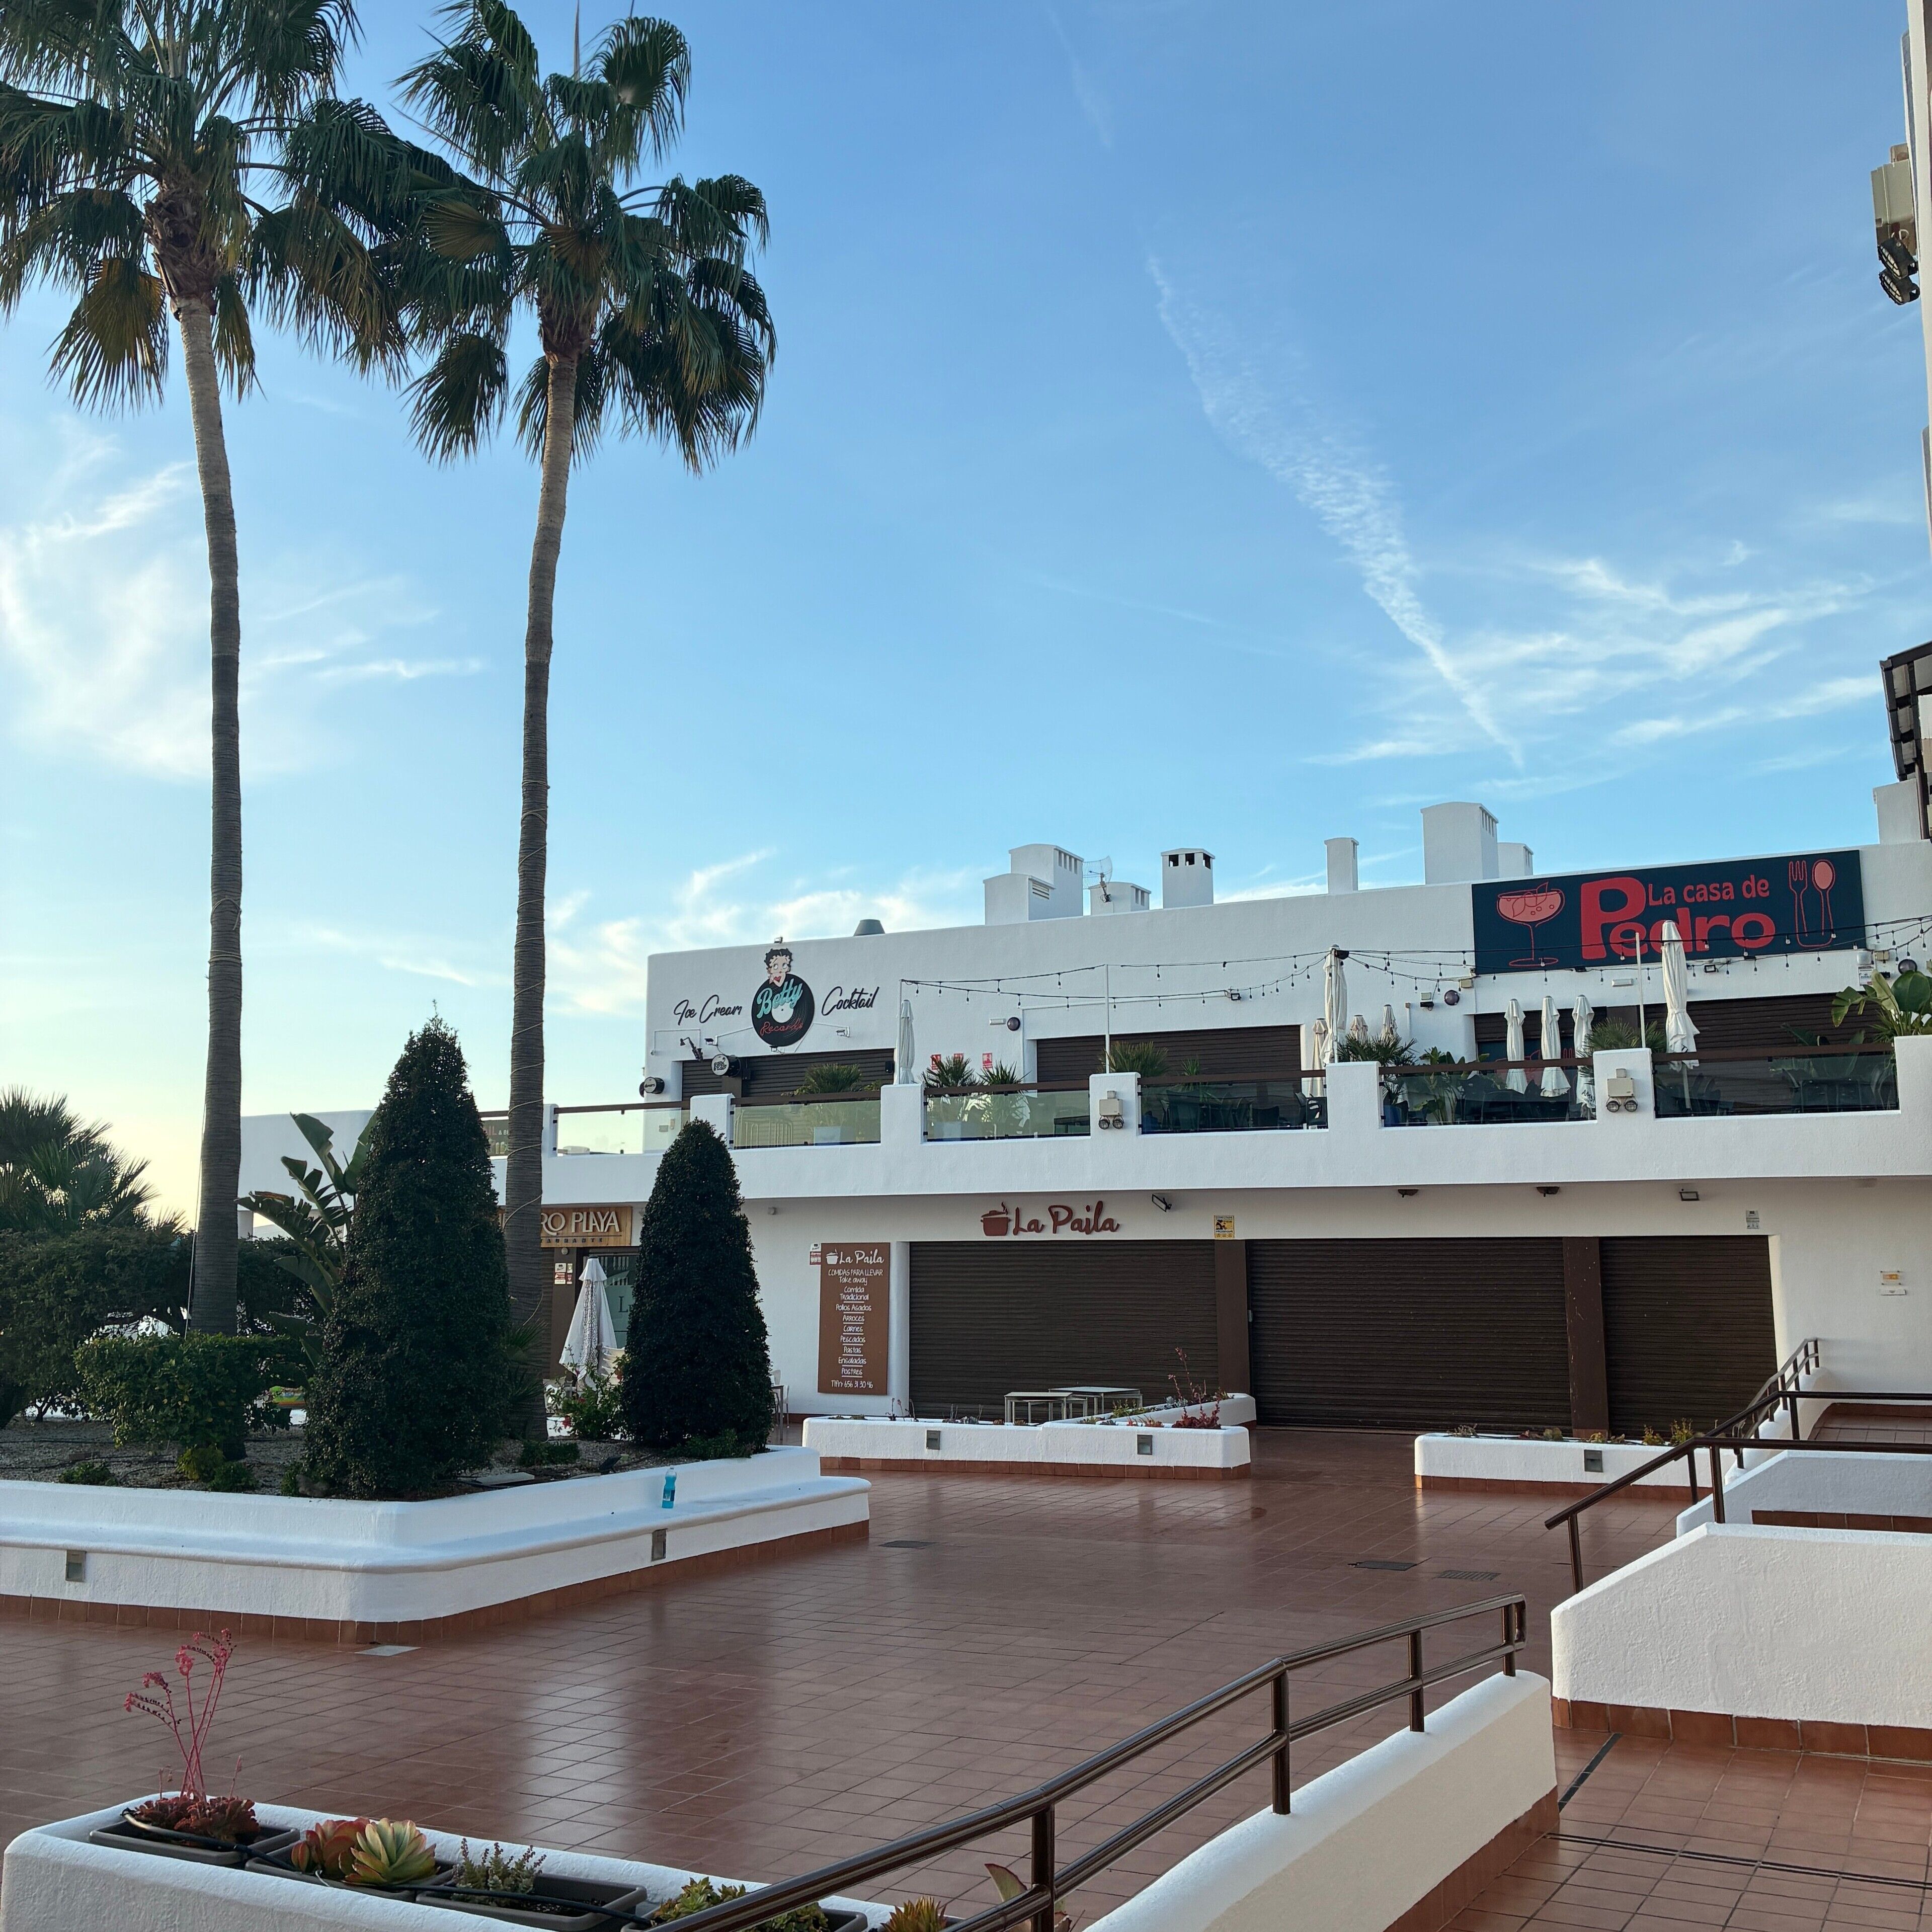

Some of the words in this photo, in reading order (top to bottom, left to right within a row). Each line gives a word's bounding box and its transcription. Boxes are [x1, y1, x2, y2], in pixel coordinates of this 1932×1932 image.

[1648, 883, 1675, 906] La
[1683, 881, 1734, 903] casa
[1742, 874, 1769, 899] de
[1580, 877, 1776, 960] Pedro
[673, 999, 697, 1026] Ice
[699, 994, 742, 1024] Cream
[756, 978, 803, 1019] Betty
[821, 986, 879, 1016] Cocktail
[571, 1211, 620, 1233] PLAYA
[1012, 1206, 1045, 1236] La
[1048, 1200, 1120, 1235] Paila
[839, 1251, 853, 1264] La
[855, 1249, 884, 1265] Paila
